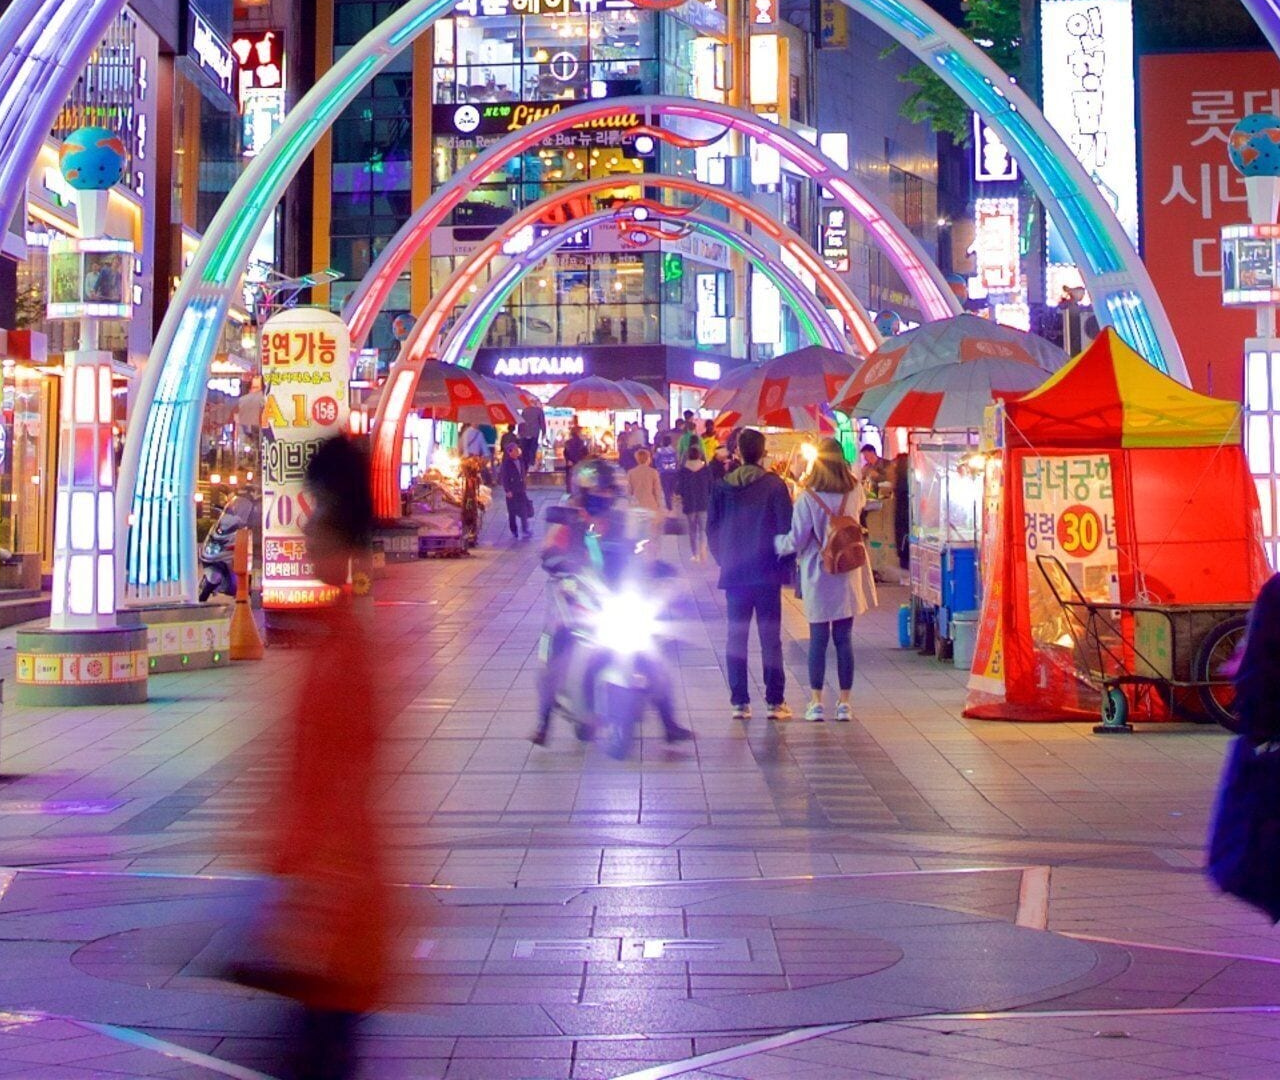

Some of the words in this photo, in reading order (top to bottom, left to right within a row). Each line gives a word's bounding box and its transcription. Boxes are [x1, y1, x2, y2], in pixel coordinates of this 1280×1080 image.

[494, 356, 584, 377] ARITAUM
[1023, 457, 1112, 501] 남녀궁합
[1024, 512, 1055, 550] 경력
[1062, 511, 1099, 552] 30
